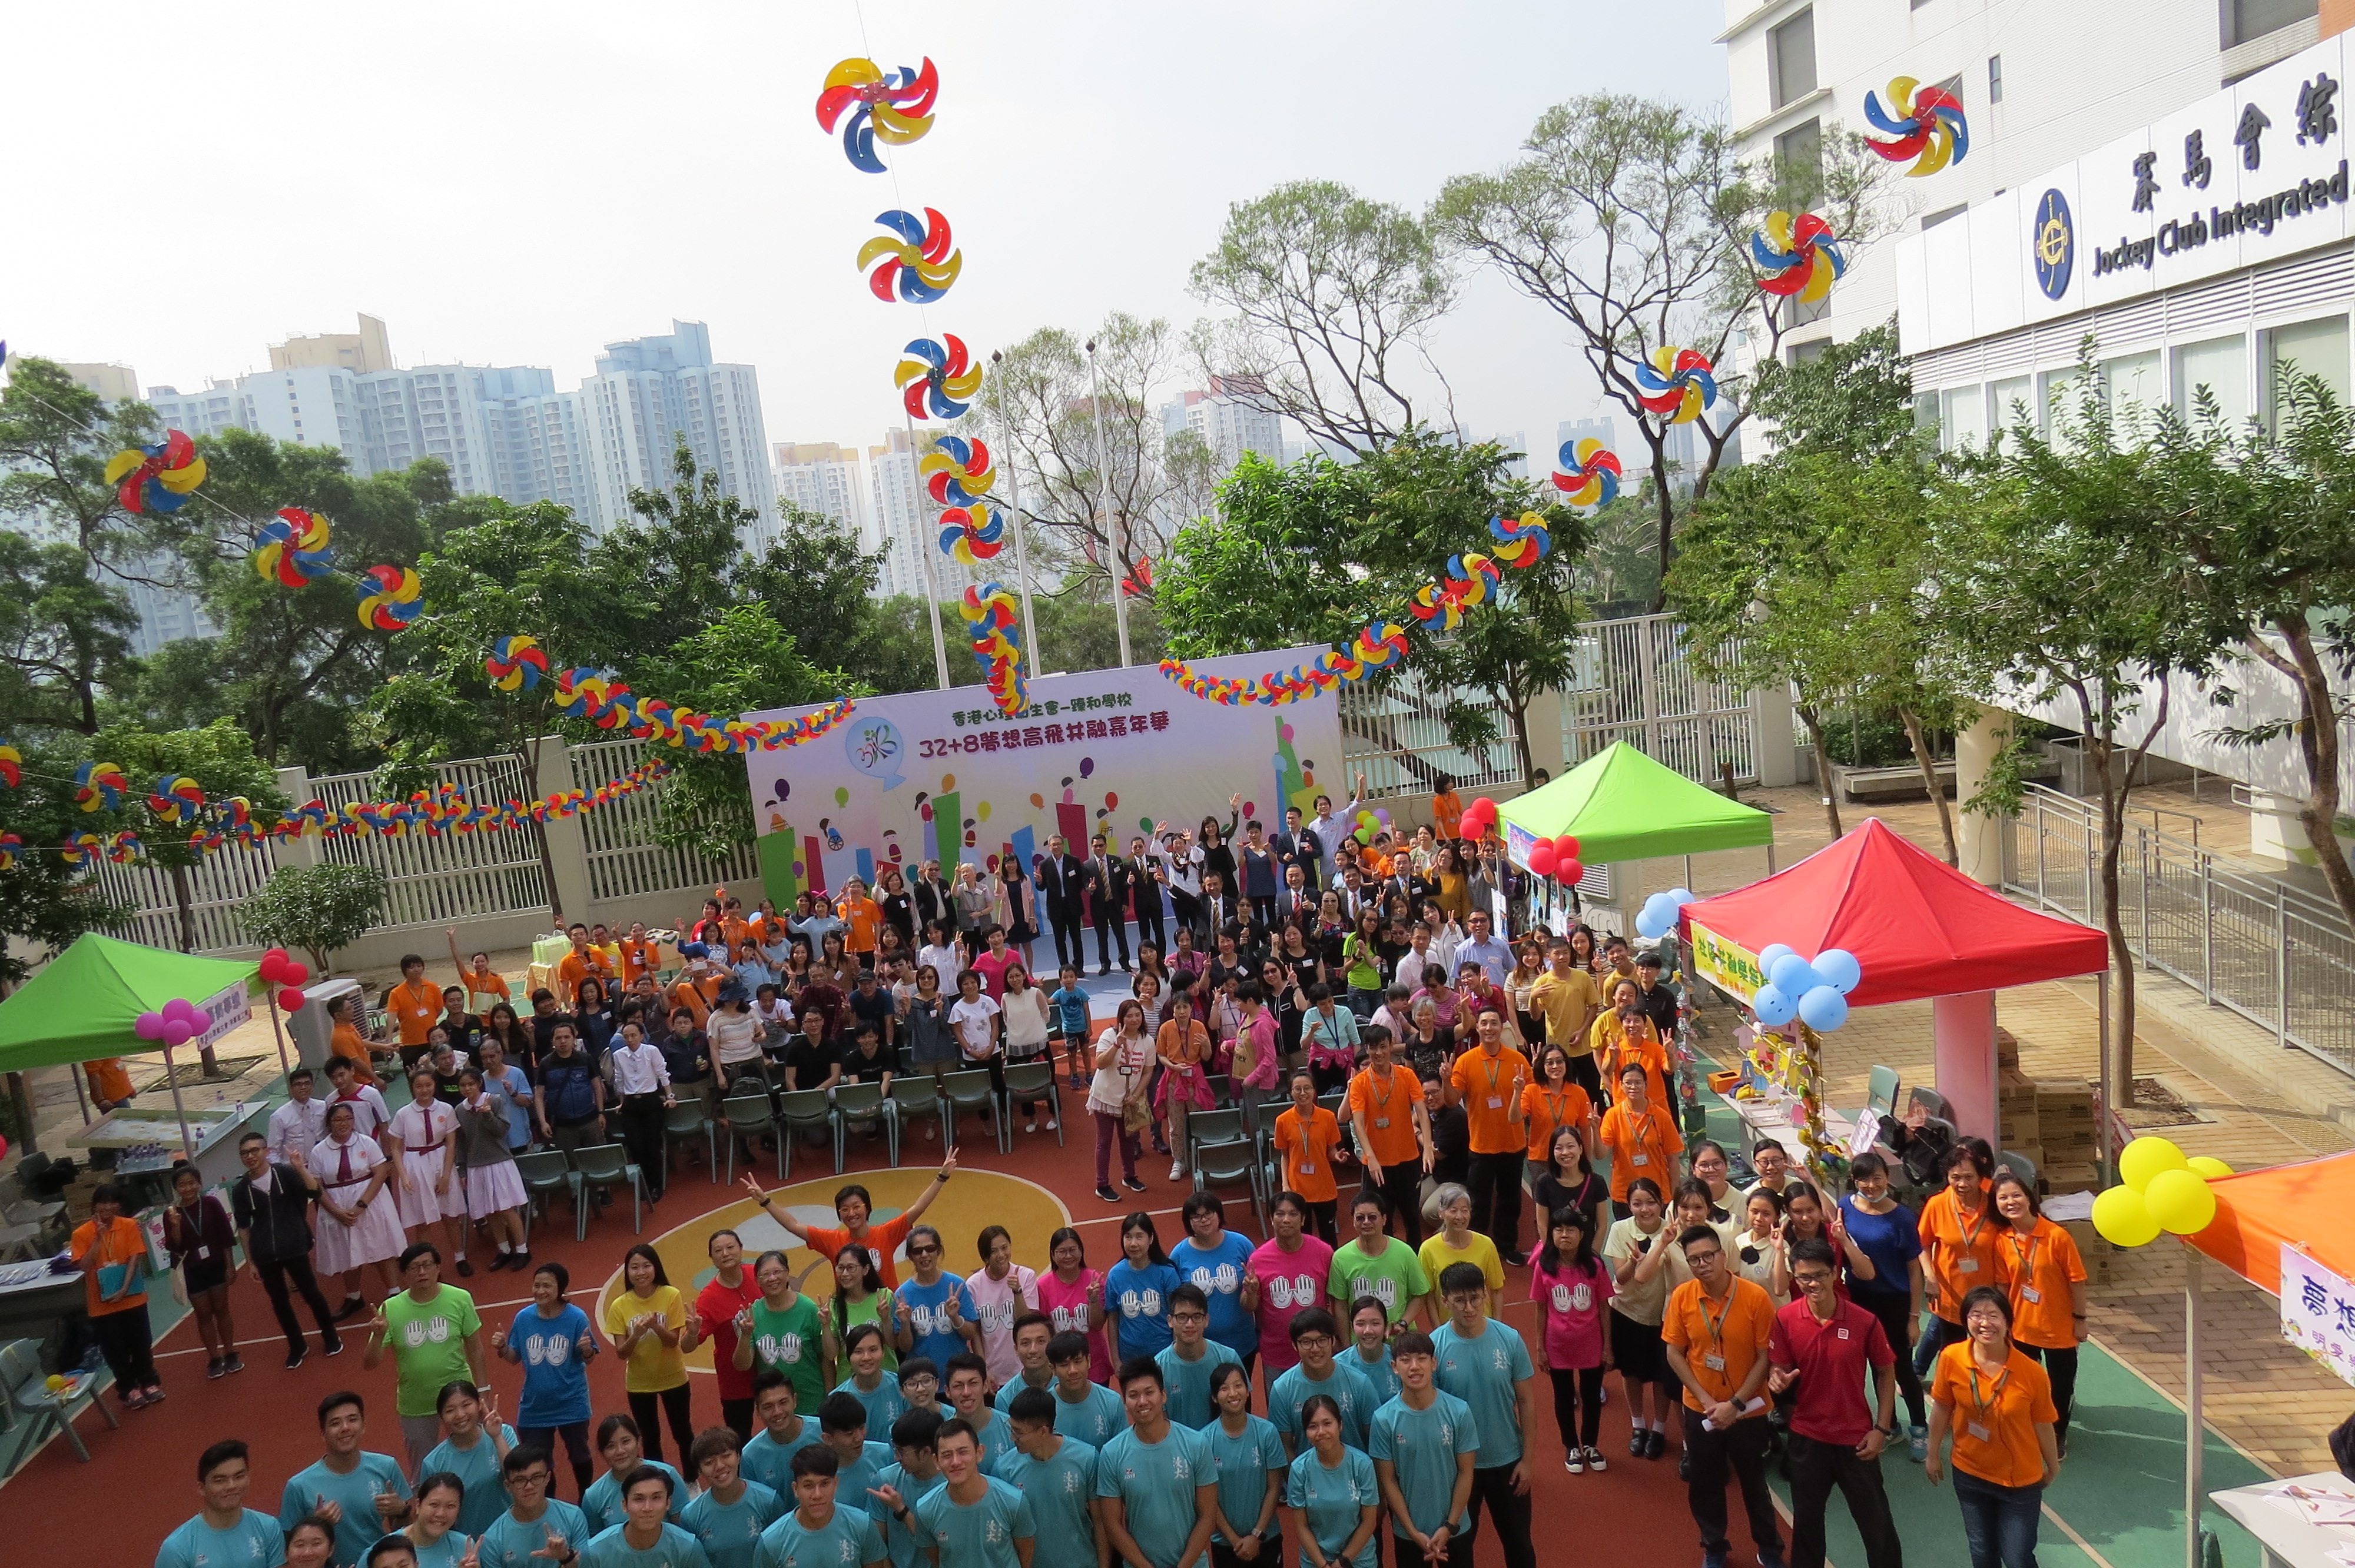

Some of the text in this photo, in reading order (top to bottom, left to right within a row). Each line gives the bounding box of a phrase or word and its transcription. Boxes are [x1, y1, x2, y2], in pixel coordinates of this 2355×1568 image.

[2131, 72, 2339, 213] 賽馬會綜
[2092, 159, 2349, 277] Jockey Club Integrated
[919, 710, 1170, 758] 32+8夢想高飛共融嘉年華
